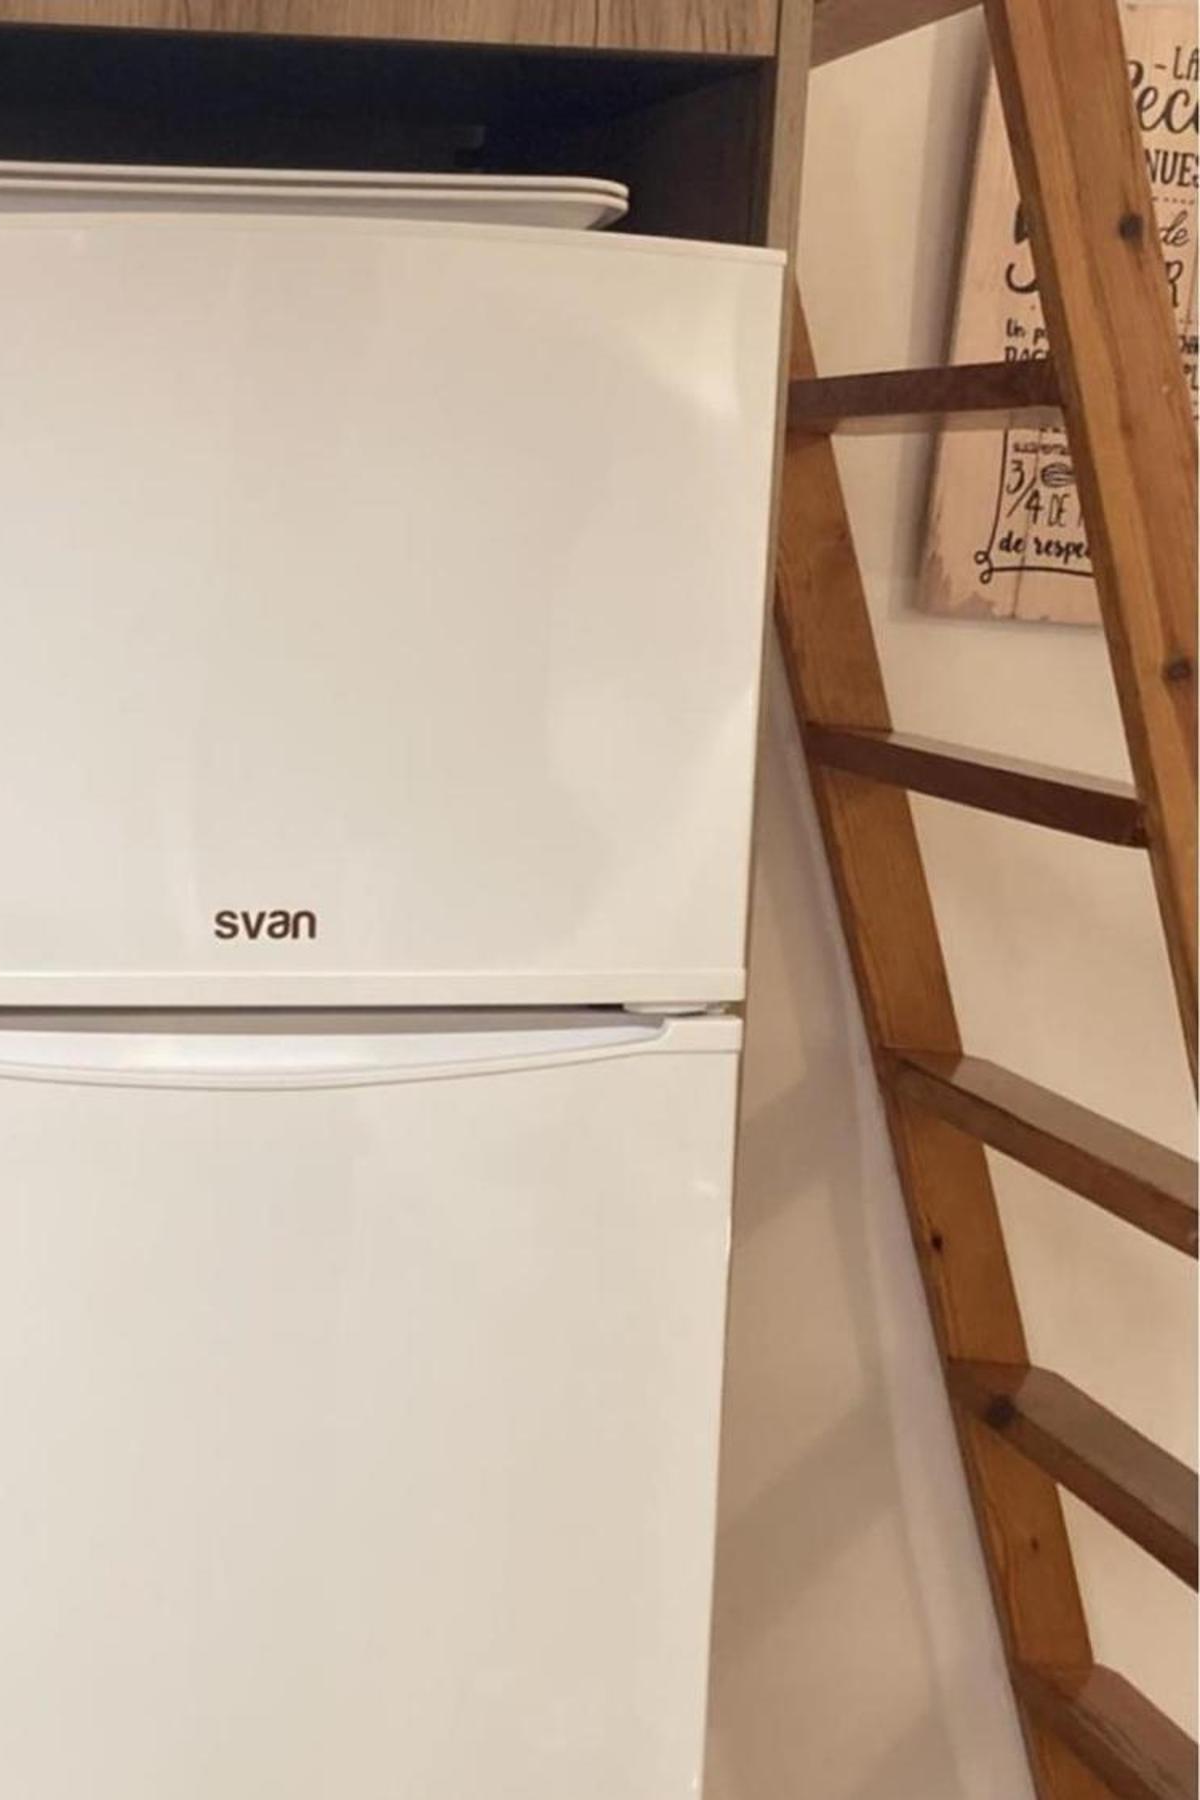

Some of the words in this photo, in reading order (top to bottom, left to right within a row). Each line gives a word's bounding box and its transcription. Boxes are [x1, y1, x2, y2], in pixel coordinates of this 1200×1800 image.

[999, 530, 1025, 554] de
[1033, 536, 1091, 565] respe
[213, 909, 317, 941] svan
